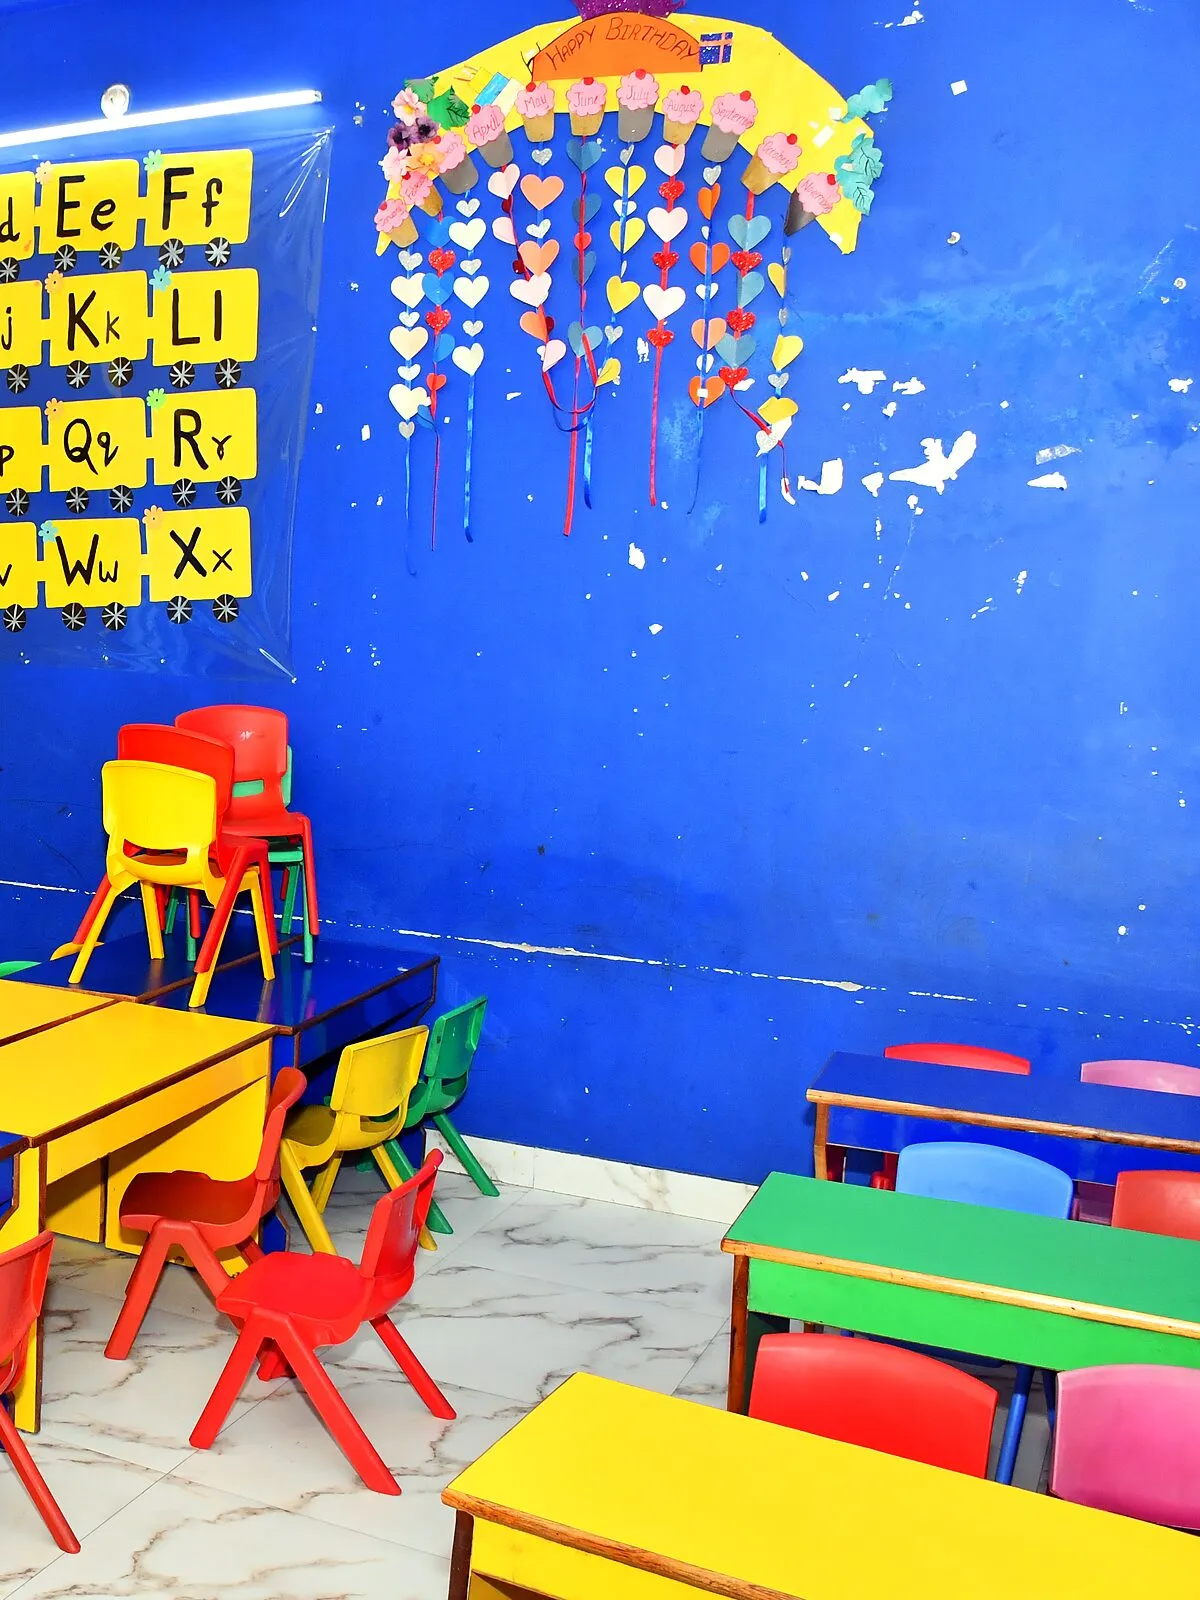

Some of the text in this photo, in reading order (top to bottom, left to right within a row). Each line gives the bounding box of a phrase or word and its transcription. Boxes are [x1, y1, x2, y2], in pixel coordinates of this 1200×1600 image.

[546, 17, 699, 70] HAPPY BIRTHDAY
[524, 94, 548, 113] May
[574, 91, 599, 108] June
